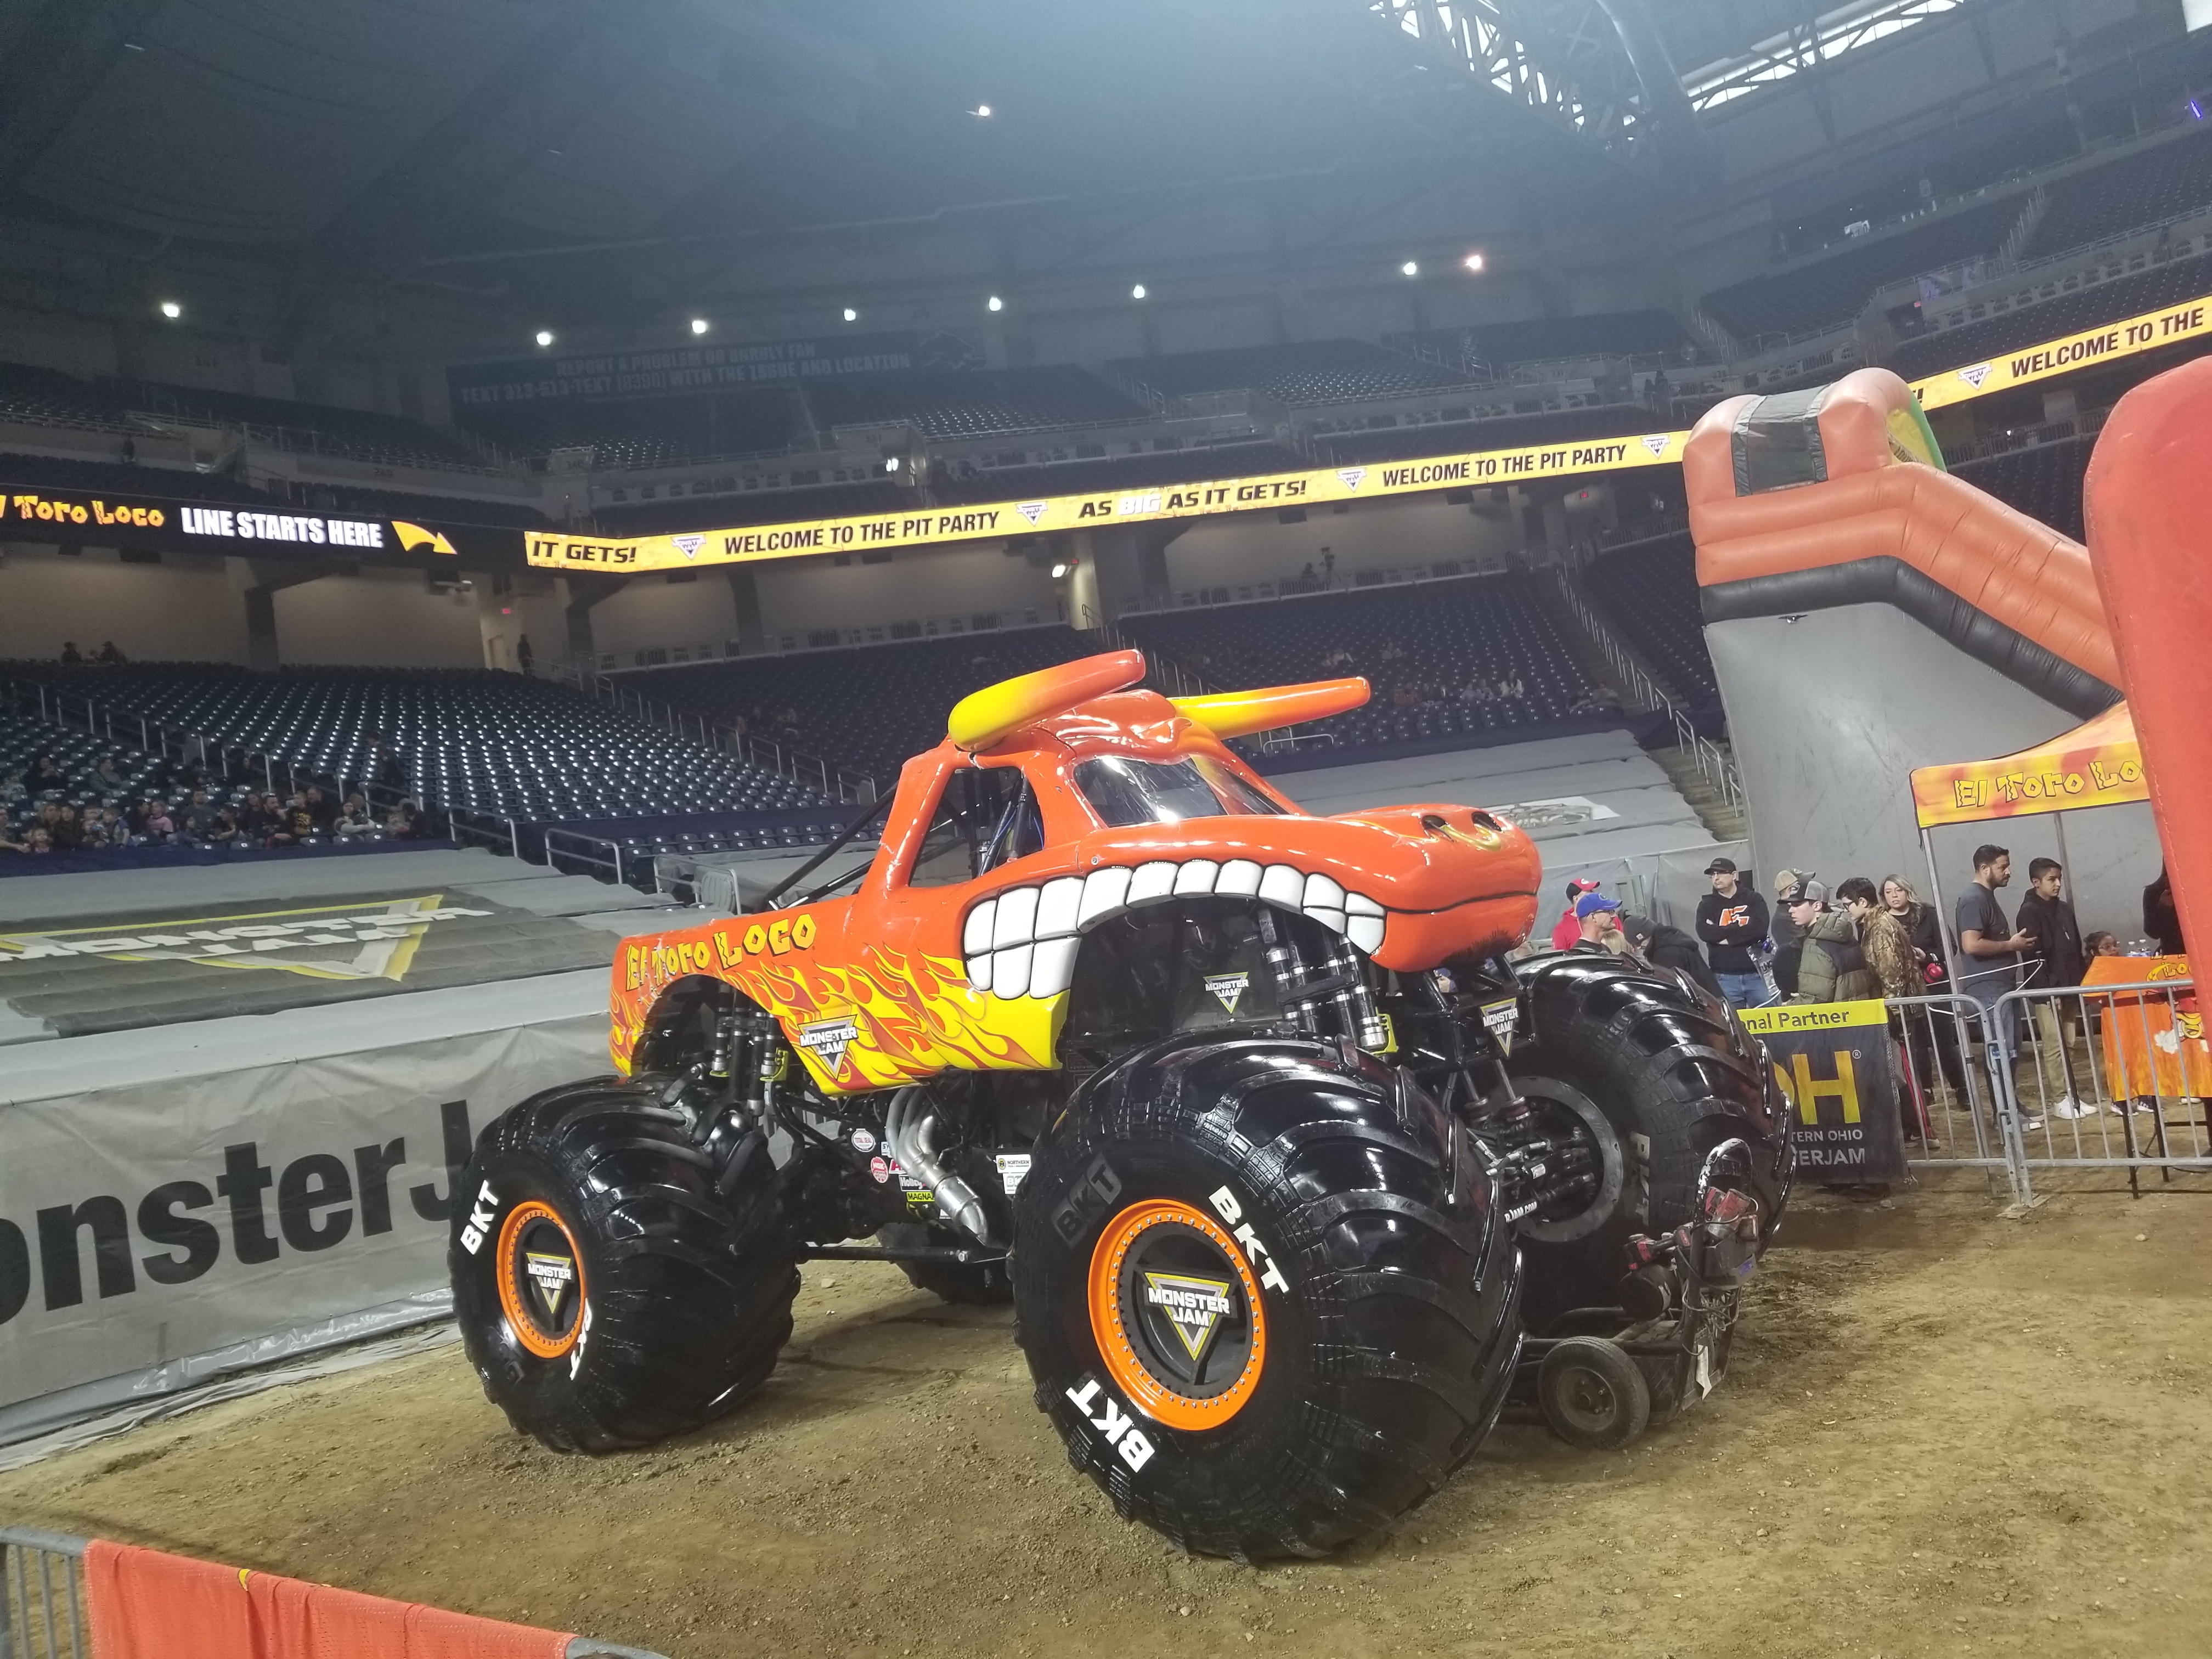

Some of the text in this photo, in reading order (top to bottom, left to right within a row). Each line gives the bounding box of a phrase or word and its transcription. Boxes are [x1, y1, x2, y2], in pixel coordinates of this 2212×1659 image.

[2011, 307, 2204, 378] WELCOME TO THE
[556, 342, 815, 376] REPORT A PROBLEM OR UNRULY FAN
[460, 385, 499, 403] TEXT
[669, 368, 712, 386] WITH
[717, 365, 745, 382] THE
[751, 361, 797, 380] ISSUE
[801, 359, 831, 376] AND
[836, 352, 910, 374] LOCATION
[1382, 444, 1627, 487] WELCOME TO THE PIT PARTY
[1078, 480, 1306, 518] AS BIG AS IT GETS!
[180, 507, 383, 548] LINE STARTS HERE
[724, 511, 1000, 555] WELCOME TO THE PIT PARTY
[532, 540, 636, 563] IT GETS!
[2089, 760, 2143, 791] Lo
[1205, 979, 1249, 992] MONSTER
[1218, 987, 1239, 997] JAM
[1483, 1007, 1518, 1027] MONSTER
[1496, 1020, 1513, 1034] JAM
[1747, 1010, 1849, 1030] nal Partner
[799, 1026, 859, 1047] MONSTER
[818, 1042, 844, 1055] JAM
[1828, 1129, 1863, 1141] OHIO
[1798, 1148, 1865, 1166] ERJAM
[1006, 1175, 1022, 1188] BK
[460, 1179, 500, 1255] BKT
[1208, 1184, 1289, 1294] BKT
[527, 1263, 572, 1280] MONSTER
[540, 1276, 561, 1290] JAM
[1148, 1286, 1230, 1314] MONSTER
[1172, 1306, 1211, 1328] JAM
[1065, 1379, 1155, 1473] BKT
